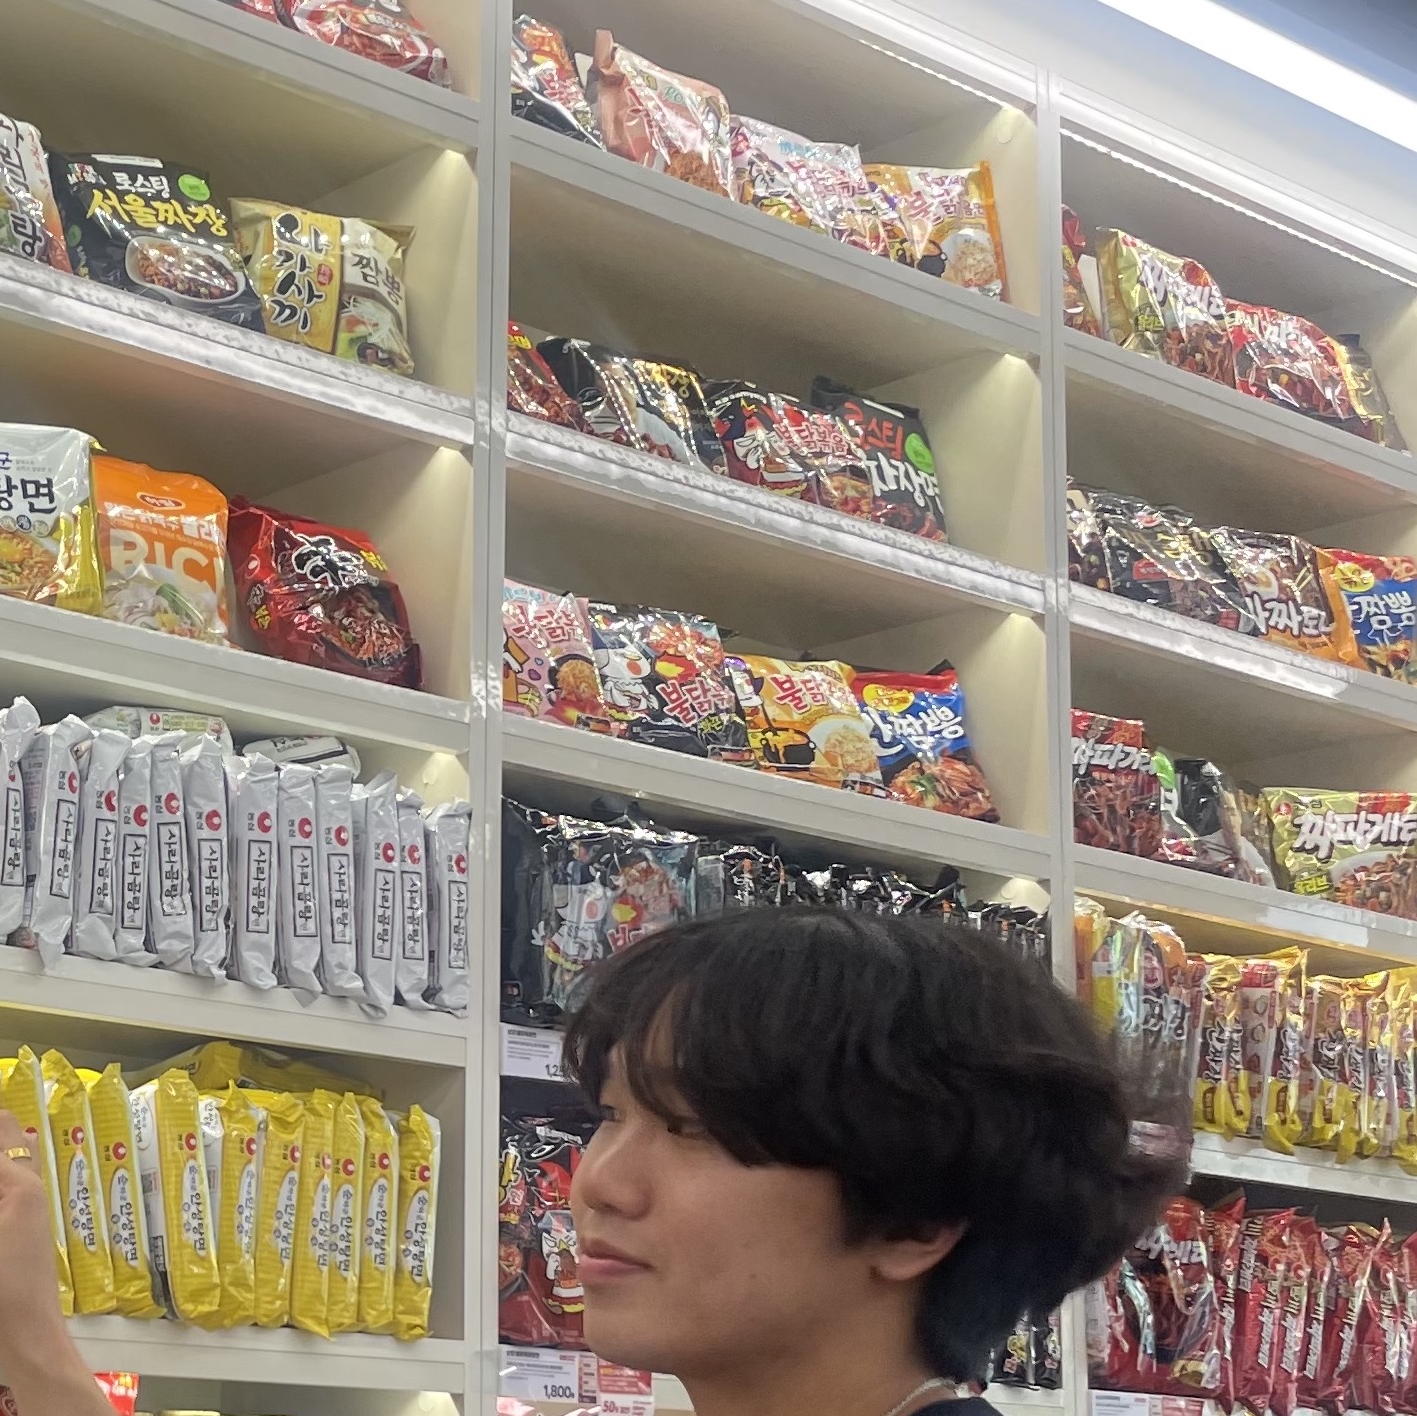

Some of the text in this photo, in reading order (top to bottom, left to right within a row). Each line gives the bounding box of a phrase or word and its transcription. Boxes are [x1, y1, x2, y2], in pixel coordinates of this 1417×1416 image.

[113, 171, 171, 200] 로스팅
[86, 188, 229, 238] 서울짜장
[350, 251, 404, 310] 짬뽕
[543, 1383, 575, 1400] 1,800
